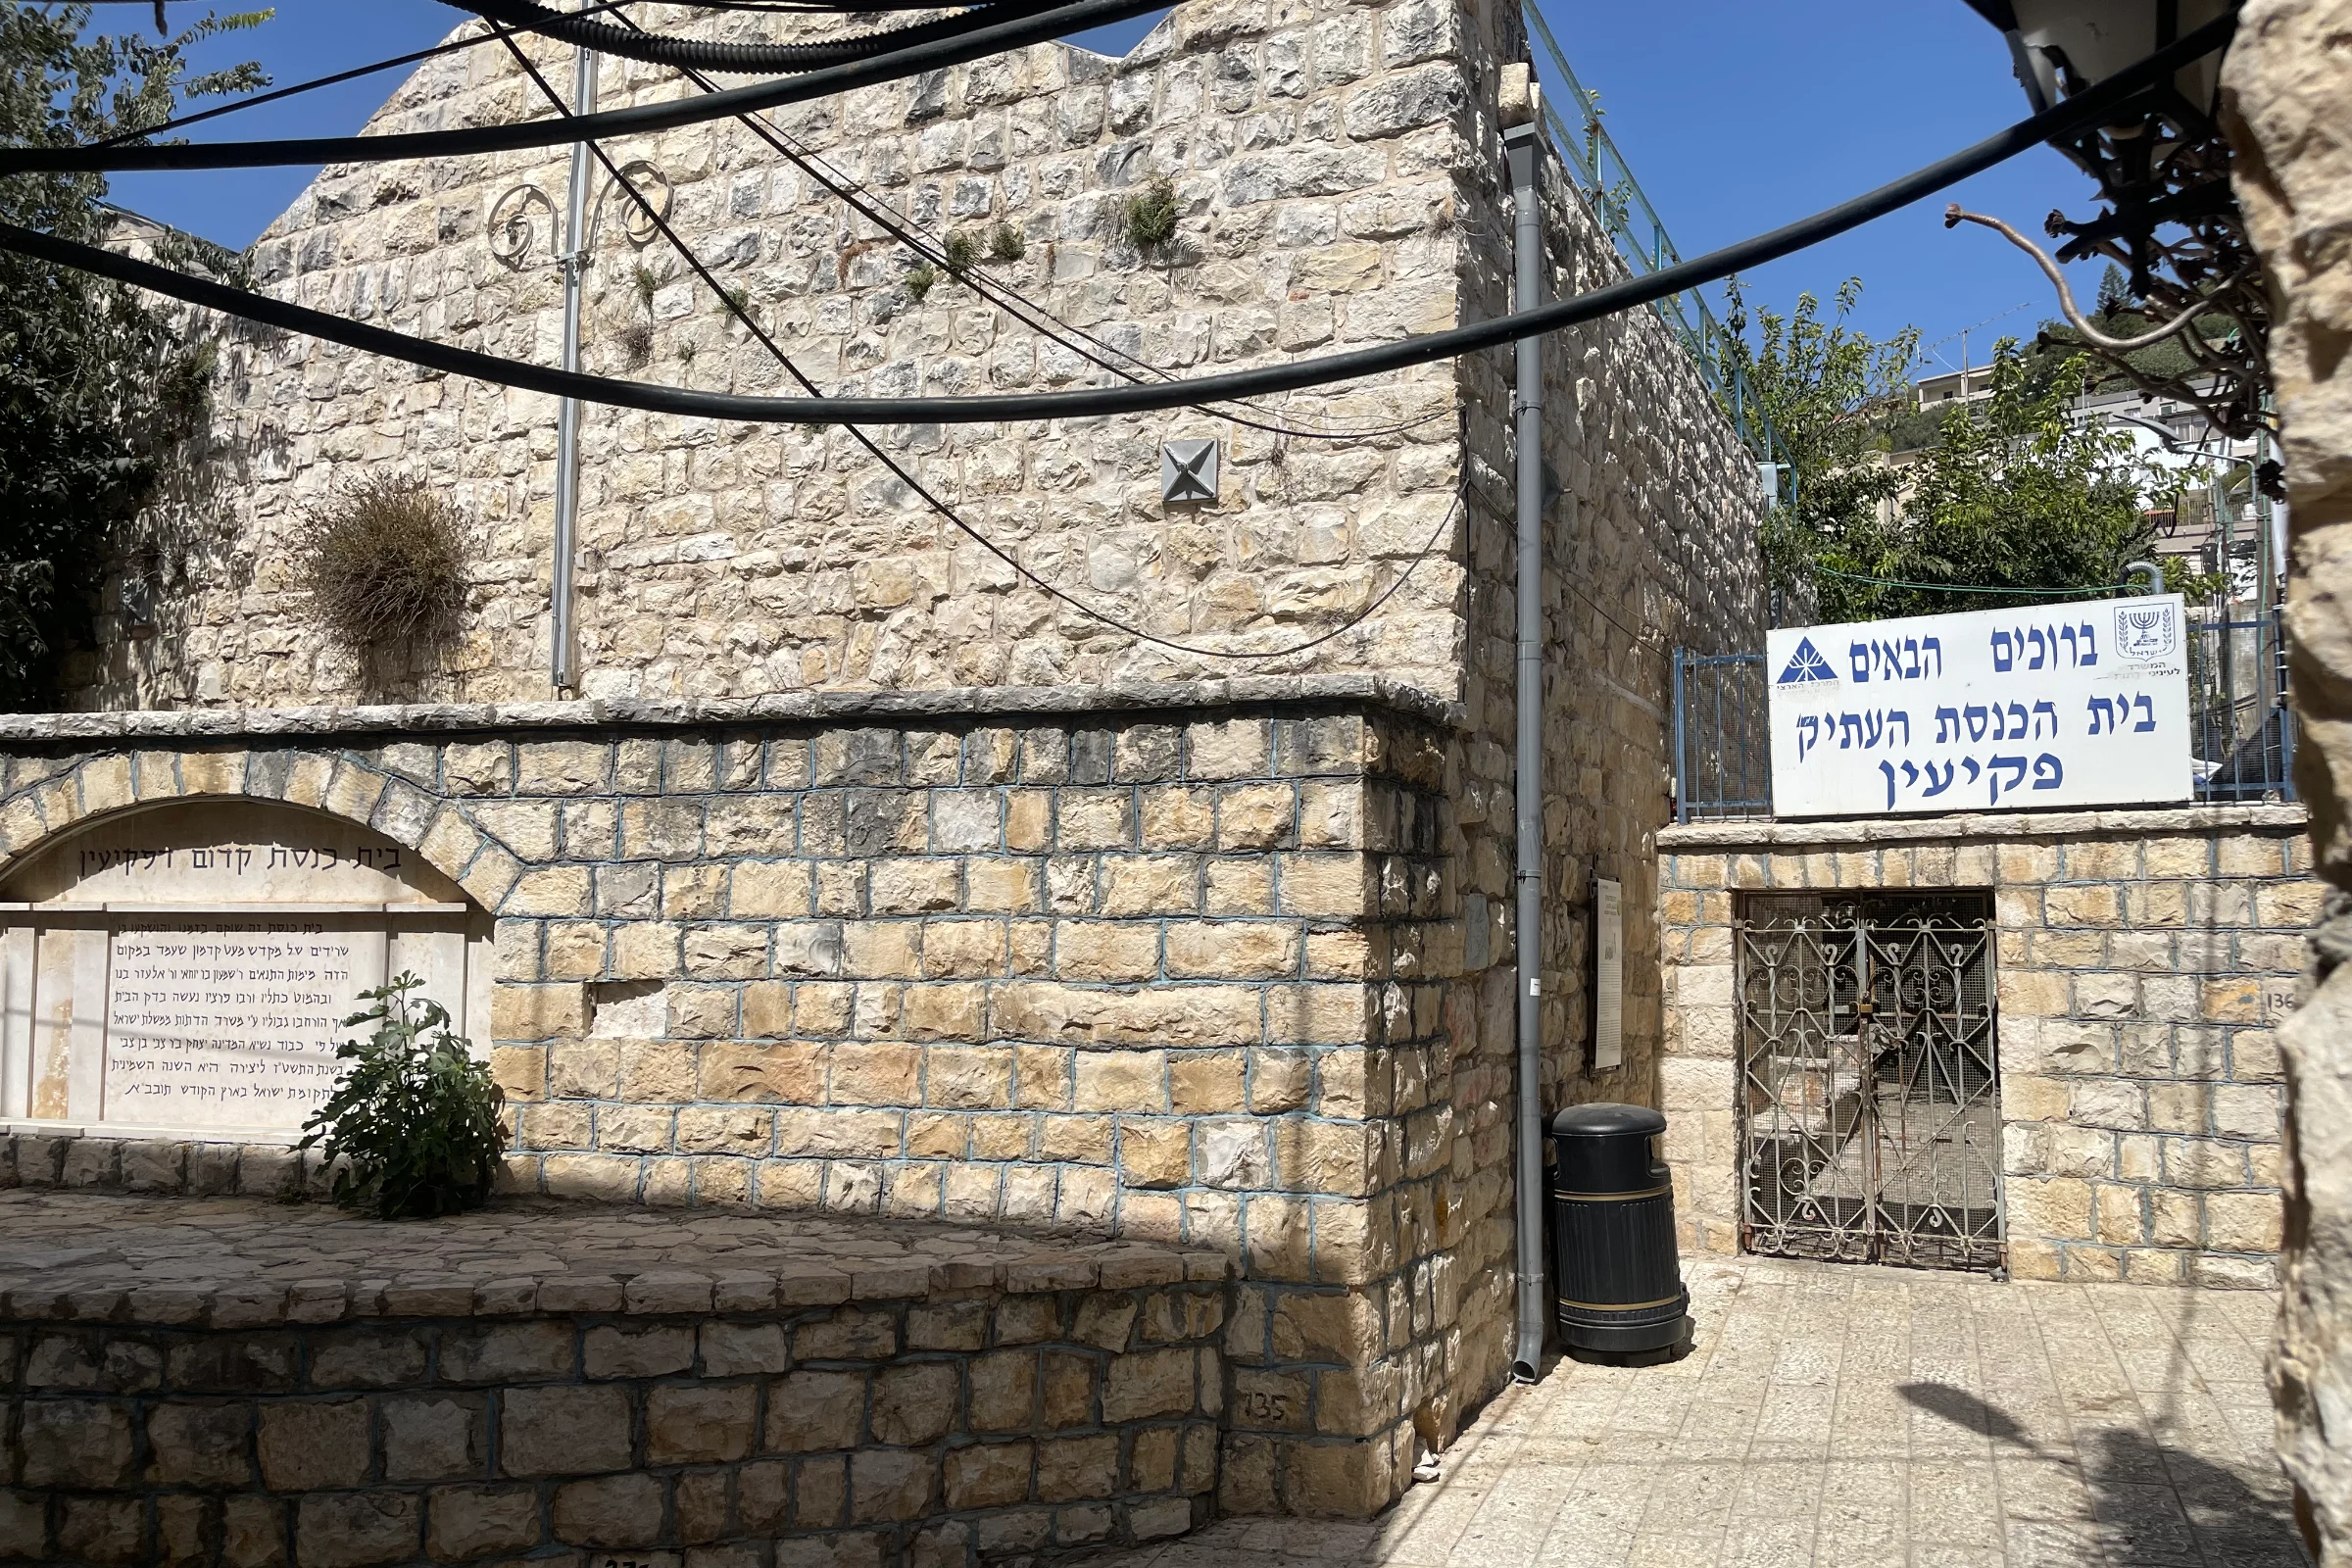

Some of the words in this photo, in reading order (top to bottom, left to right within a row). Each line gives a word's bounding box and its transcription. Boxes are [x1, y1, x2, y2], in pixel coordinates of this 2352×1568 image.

[1990, 619, 2098, 672] ברוכים
[1849, 634, 1942, 684] הבאים
[2087, 691, 2157, 736] בית
[1935, 699, 2058, 744] הכנסת
[1796, 708, 1910, 763] העתיק
[1878, 752, 2063, 810] פקיעין
[78, 847, 173, 876] דפקיעין
[192, 847, 253, 876] קדום
[267, 847, 337, 870] כנסת
[353, 847, 402, 870] בית
[216, 923, 243, 937] שוקם
[249, 923, 261, 932] זה
[268, 923, 297, 935] כנסת
[303, 923, 323, 935] בית
[118, 945, 151, 960] במקום
[157, 945, 187, 956] שעמד
[193, 945, 221, 960] קדמון
[223, 945, 245, 956] מעט
[248, 946, 282, 960] מקדש
[286, 943, 303, 956] של
[311, 946, 349, 956] שרידים
[116, 968, 129, 980] בנו
[134, 965, 165, 979] אלעזר
[181, 969, 198, 979] יוחאי
[249, 969, 284, 982] התנאים
[286, 969, 316, 982] מימות
[324, 970, 349, 980] הזה
[115, 991, 138, 1002] הבית
[144, 992, 167, 1005] בדק
[172, 992, 199, 1002] נעשה
[206, 992, 230, 1004] פרציו
[236, 994, 255, 1004] ורבו
[261, 988, 288, 1004] כתליו
[294, 992, 331, 1004] ובהמוט
[2268, 993, 2295, 1009] 136
[114, 1011, 139, 1025] ישראל
[141, 1010, 171, 1026] ממשלת
[174, 1014, 208, 1026] הדתות
[215, 1015, 243, 1027] משרד
[263, 1012, 288, 1028] גבוליו
[293, 1017, 327, 1028] הורחבו
[120, 1037, 133, 1049] צבי
[137, 1039, 147, 1051] בן
[153, 1039, 167, 1050] צבי
[186, 1039, 208, 1054] יצחק
[212, 1039, 245, 1051] המדינה
[249, 1040, 270, 1051] נשיא
[277, 1041, 304, 1052] כבוד
[316, 1041, 325, 1052] פי
[112, 1058, 155, 1072] השמינית
[163, 1060, 192, 1072] השנה
[198, 1062, 218, 1072] היא
[230, 1058, 265, 1074] ליצירה
[316, 1064, 343, 1076] בשנת
[180, 1086, 216, 1100] הקודש
[221, 1086, 247, 1102] בארץ
[254, 1082, 284, 1098] ישראל
[287, 1085, 333, 1103] לתקומת
[1245, 1392, 1287, 1421] 135
